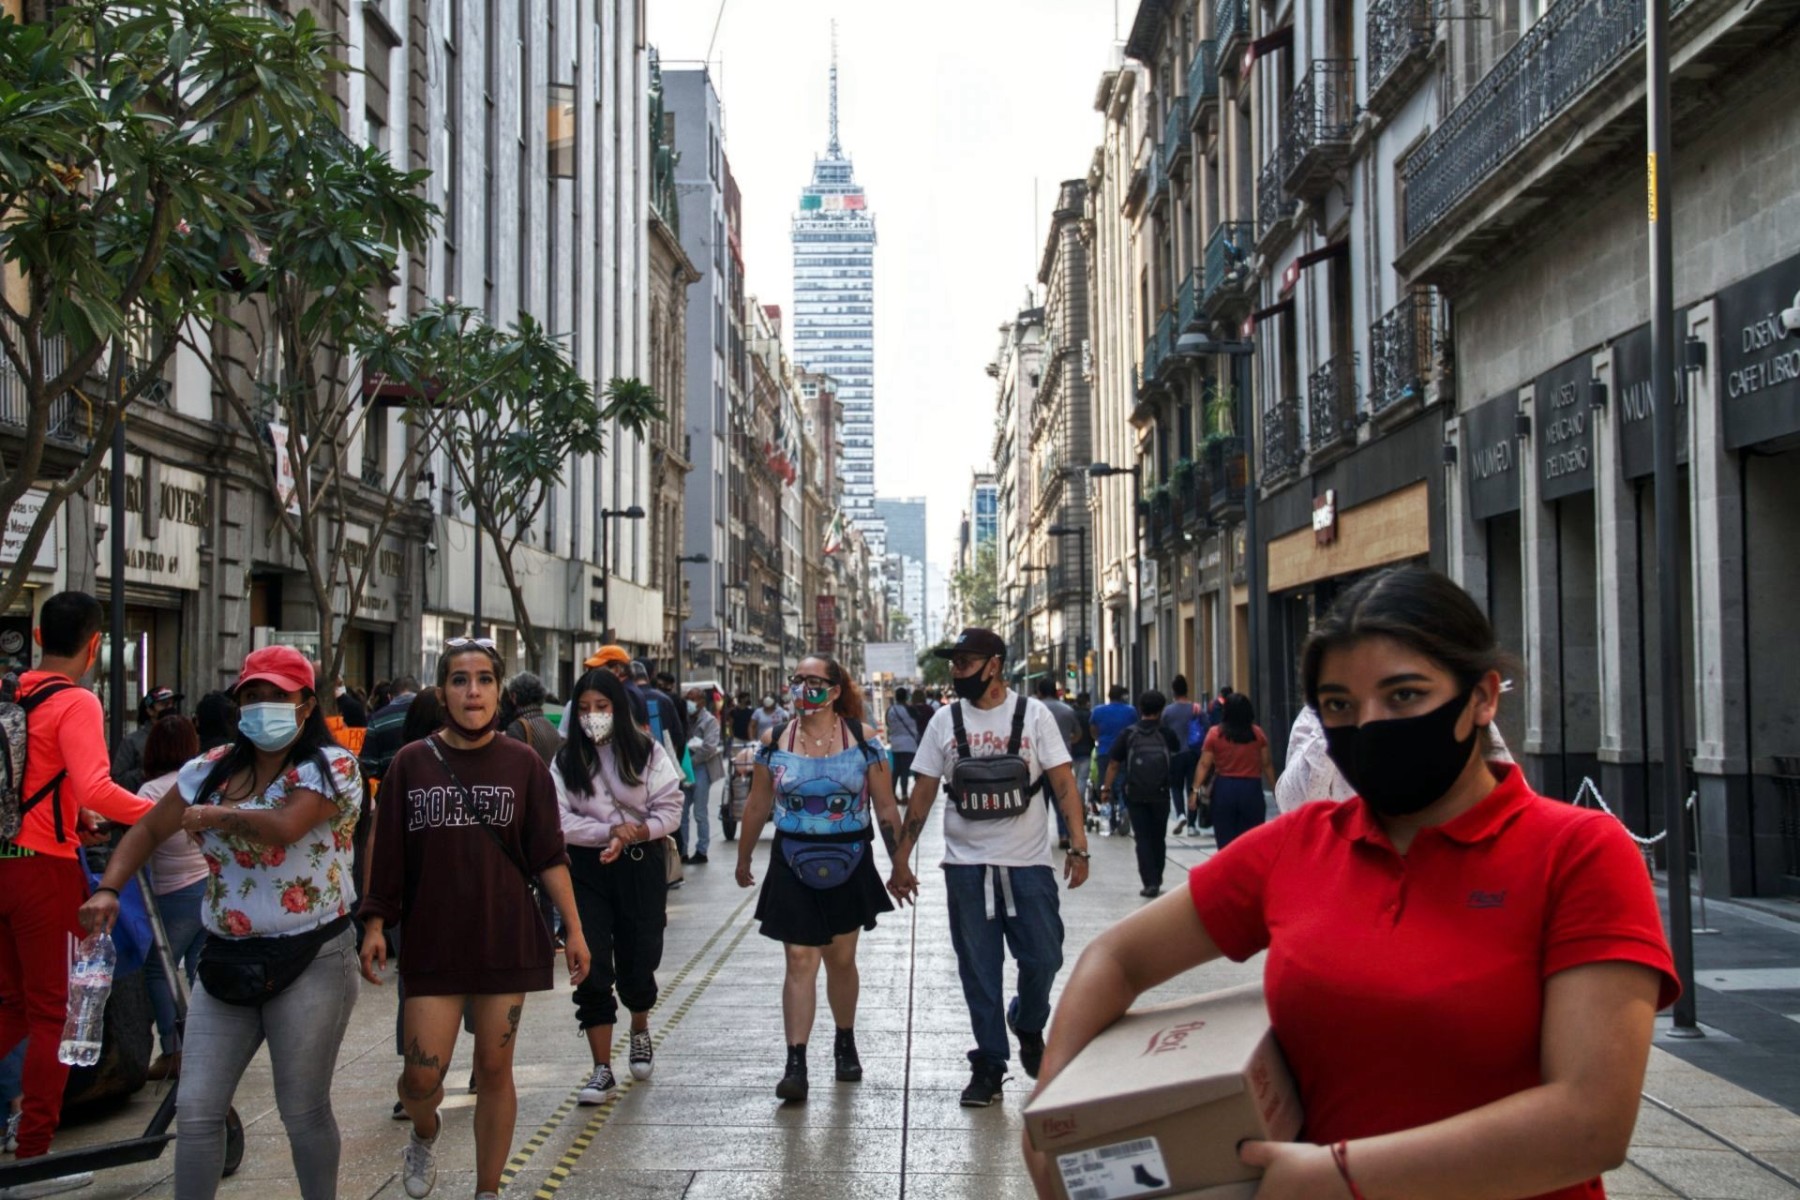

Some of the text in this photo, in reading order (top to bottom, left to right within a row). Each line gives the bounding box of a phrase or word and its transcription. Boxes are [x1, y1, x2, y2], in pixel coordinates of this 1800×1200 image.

[1742, 312, 1790, 353] DISEÑO
[408, 785, 515, 832] BORED
[961, 788, 1023, 810] JORDAN
